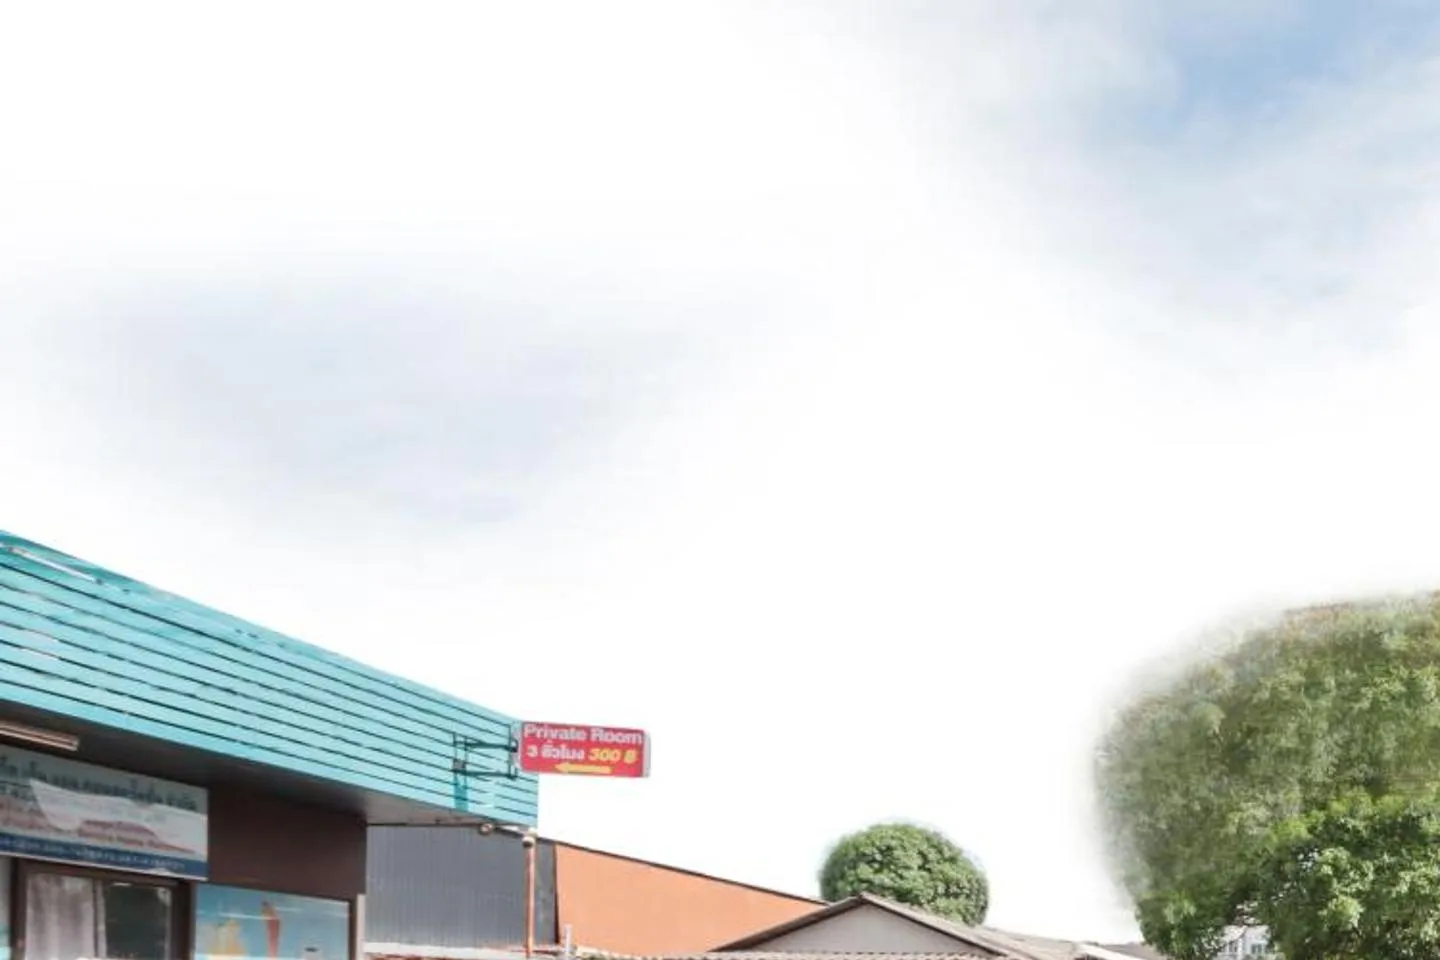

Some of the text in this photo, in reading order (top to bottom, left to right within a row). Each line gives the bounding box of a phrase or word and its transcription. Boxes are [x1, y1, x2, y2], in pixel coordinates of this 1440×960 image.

[523, 723, 643, 745] Private Room
[526, 744, 539, 758] 3
[587, 747, 622, 762] 300
